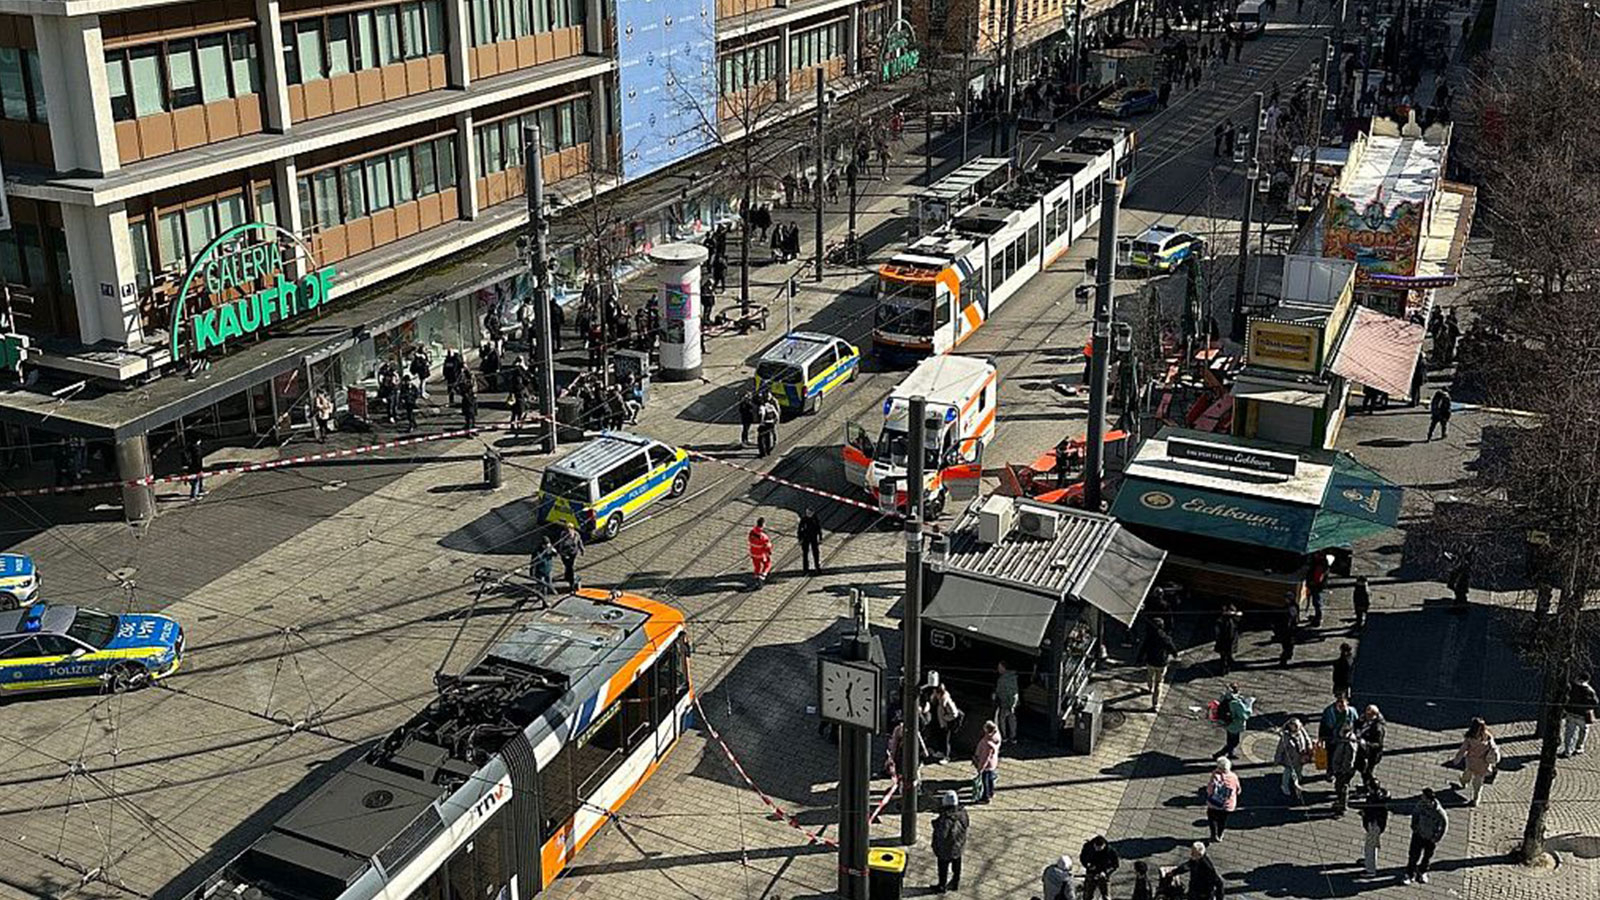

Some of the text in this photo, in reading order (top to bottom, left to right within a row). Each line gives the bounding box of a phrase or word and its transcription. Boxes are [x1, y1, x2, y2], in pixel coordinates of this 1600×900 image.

[207, 243, 283, 294] GALERIA
[1181, 497, 1279, 525] Eichbaum
[48, 664, 93, 676] POLIZEI
[475, 784, 503, 817] rnv
